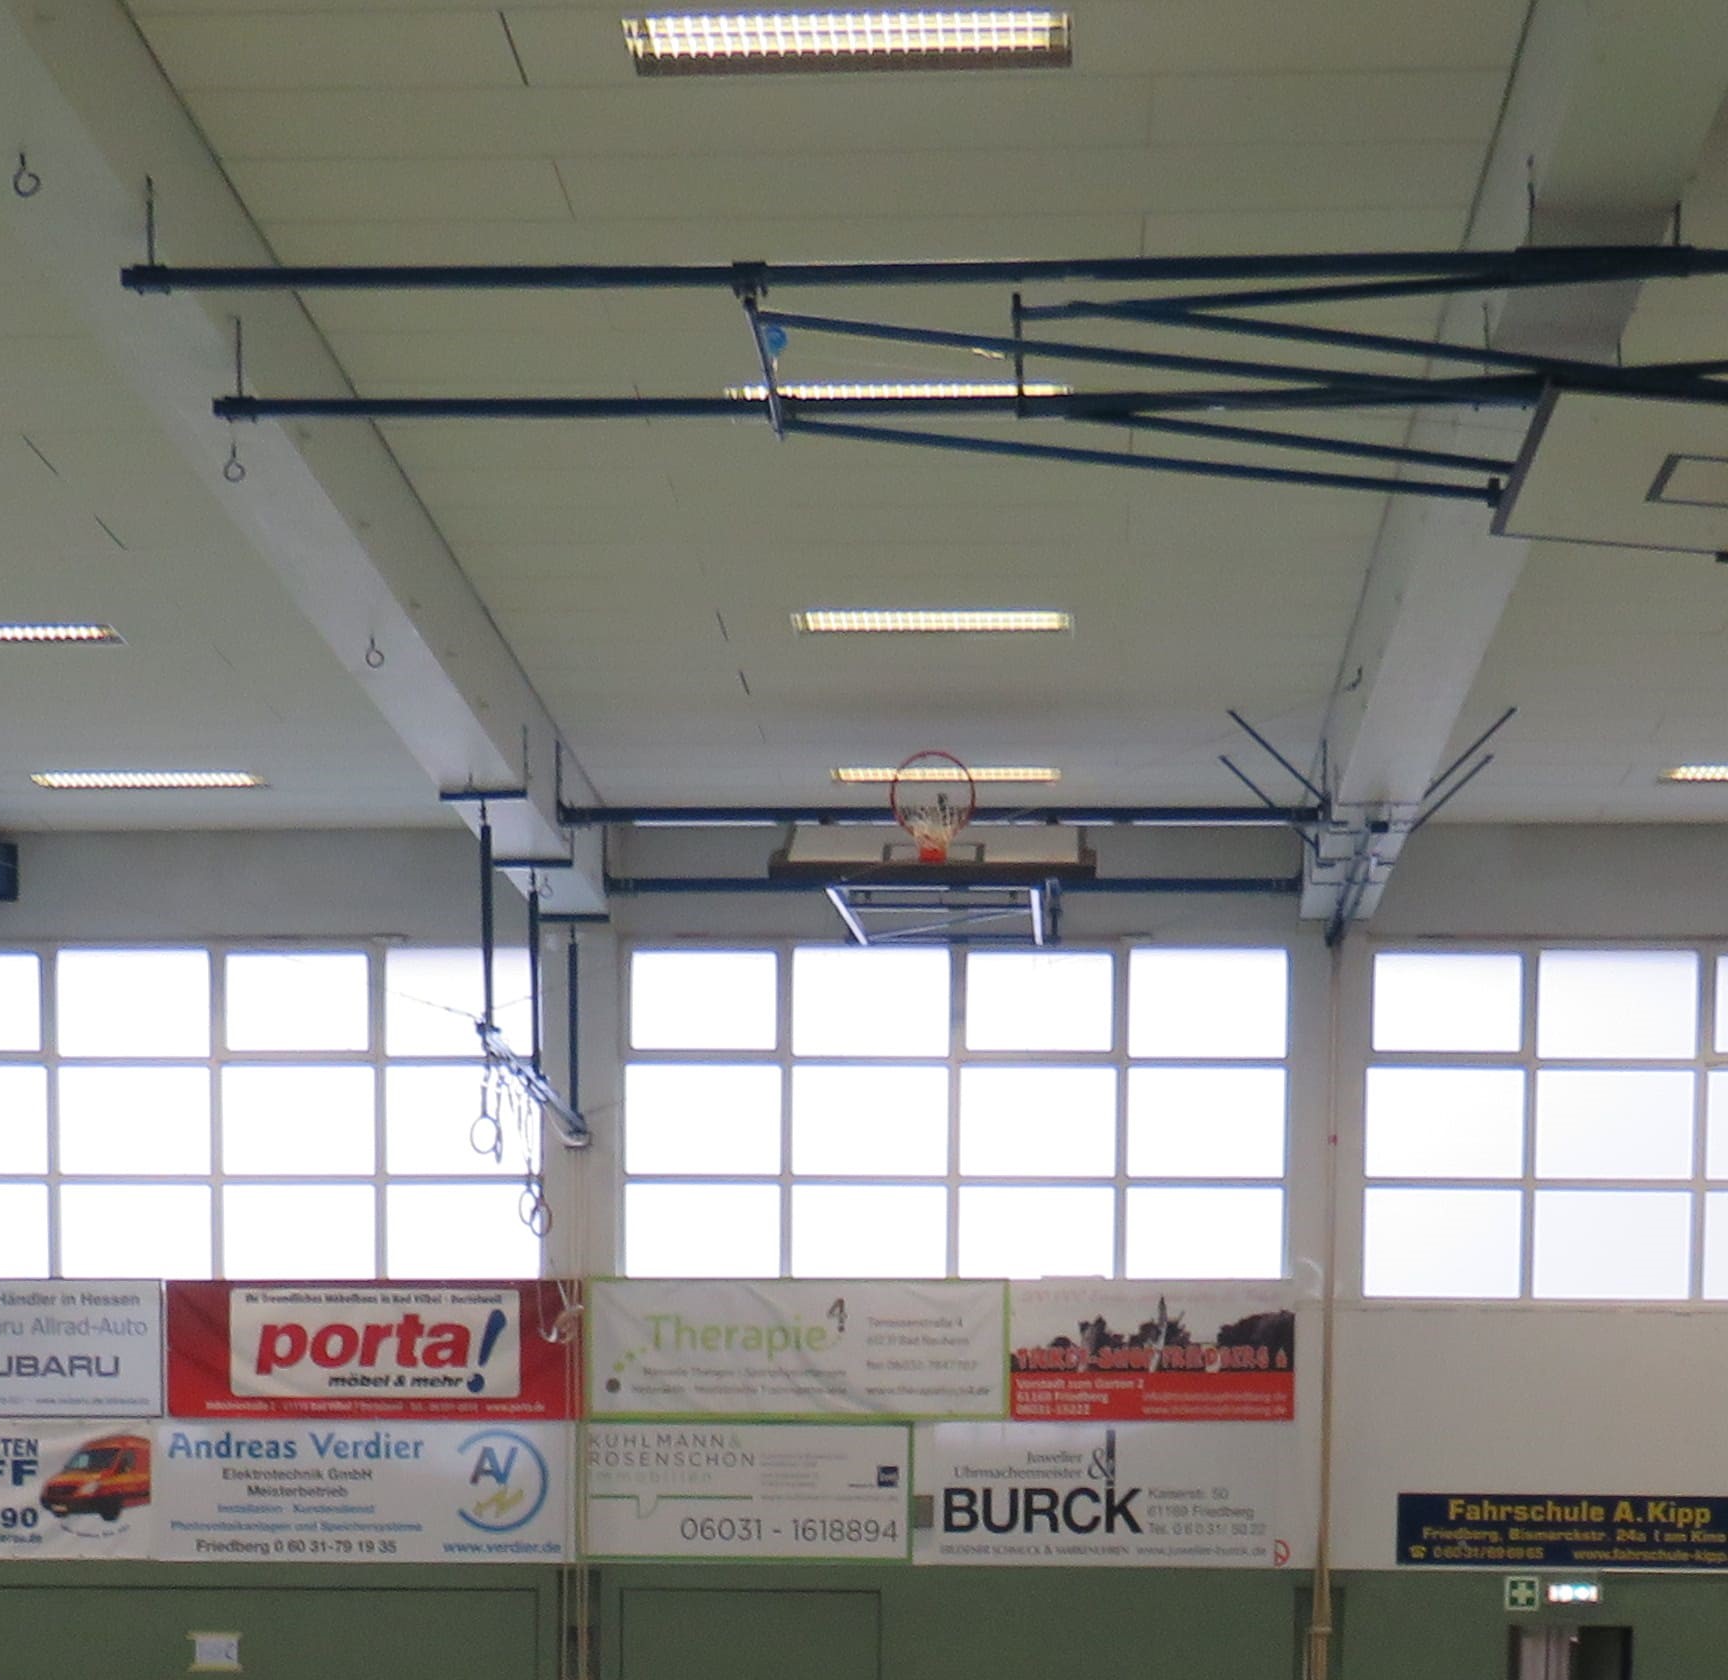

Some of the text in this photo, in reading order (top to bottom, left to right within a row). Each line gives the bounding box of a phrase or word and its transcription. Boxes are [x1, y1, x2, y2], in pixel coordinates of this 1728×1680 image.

[60, 1292, 76, 1306] in
[79, 1292, 142, 1307] Hessen
[30, 1316, 148, 1337] Allrad-Auto
[646, 1315, 828, 1359] Therapie
[328, 1373, 464, 1388] möbel & mehr
[168, 1431, 424, 1459] Andreas Verdier
[1026, 1452, 1083, 1465] Juwelier
[1086, 1446, 1116, 1481] &
[222, 1468, 373, 1481] Elektrotechnik GmbH
[247, 1484, 349, 1498] Meisterbetrieb
[943, 1485, 1144, 1535] BURCK
[1448, 1500, 1605, 1523] Fahrschule
[681, 1517, 763, 1542] 06031
[791, 1518, 899, 1543] 1618894
[196, 1539, 270, 1555] Friedberg
